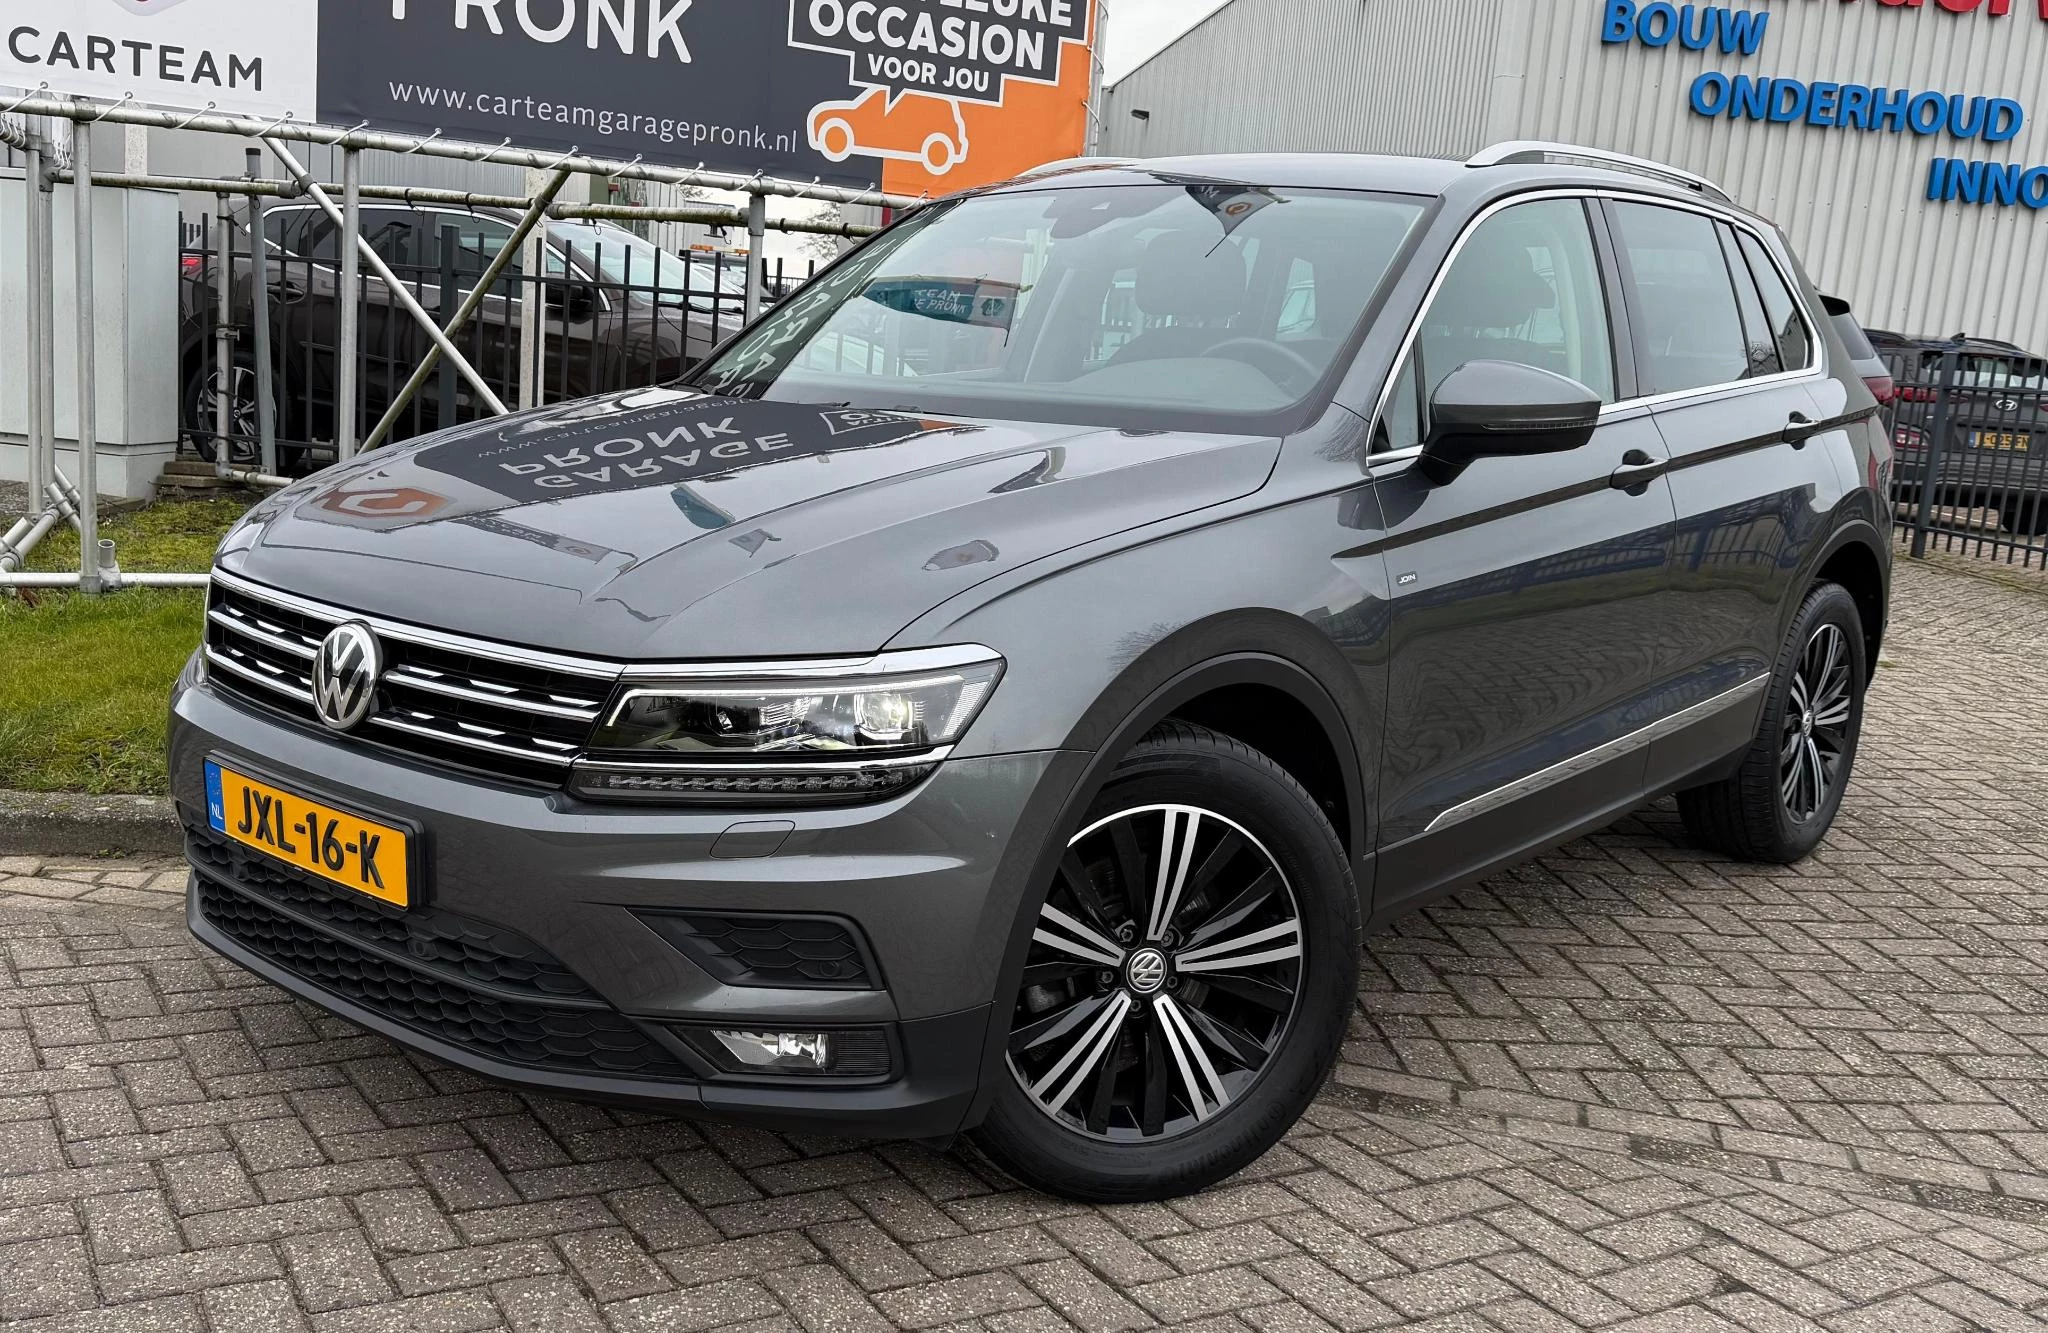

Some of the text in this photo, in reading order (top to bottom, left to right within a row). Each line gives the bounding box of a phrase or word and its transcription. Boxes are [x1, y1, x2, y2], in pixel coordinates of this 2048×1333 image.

[808, 0, 1044, 70] OCCASION
[1601, 0, 1770, 55] BOUW
[8, 26, 262, 91] CARTEAM
[868, 53, 989, 92] VOOR JOU
[389, 81, 797, 153] www.carteamgaragepronk.nl
[1689, 71, 2023, 142] ONDERHOUD
[1927, 157, 2048, 209] INNO
[1398, 573, 1417, 584] JOIN
[211, 802, 223, 820] NL
[238, 786, 384, 889] JXL-16-K
